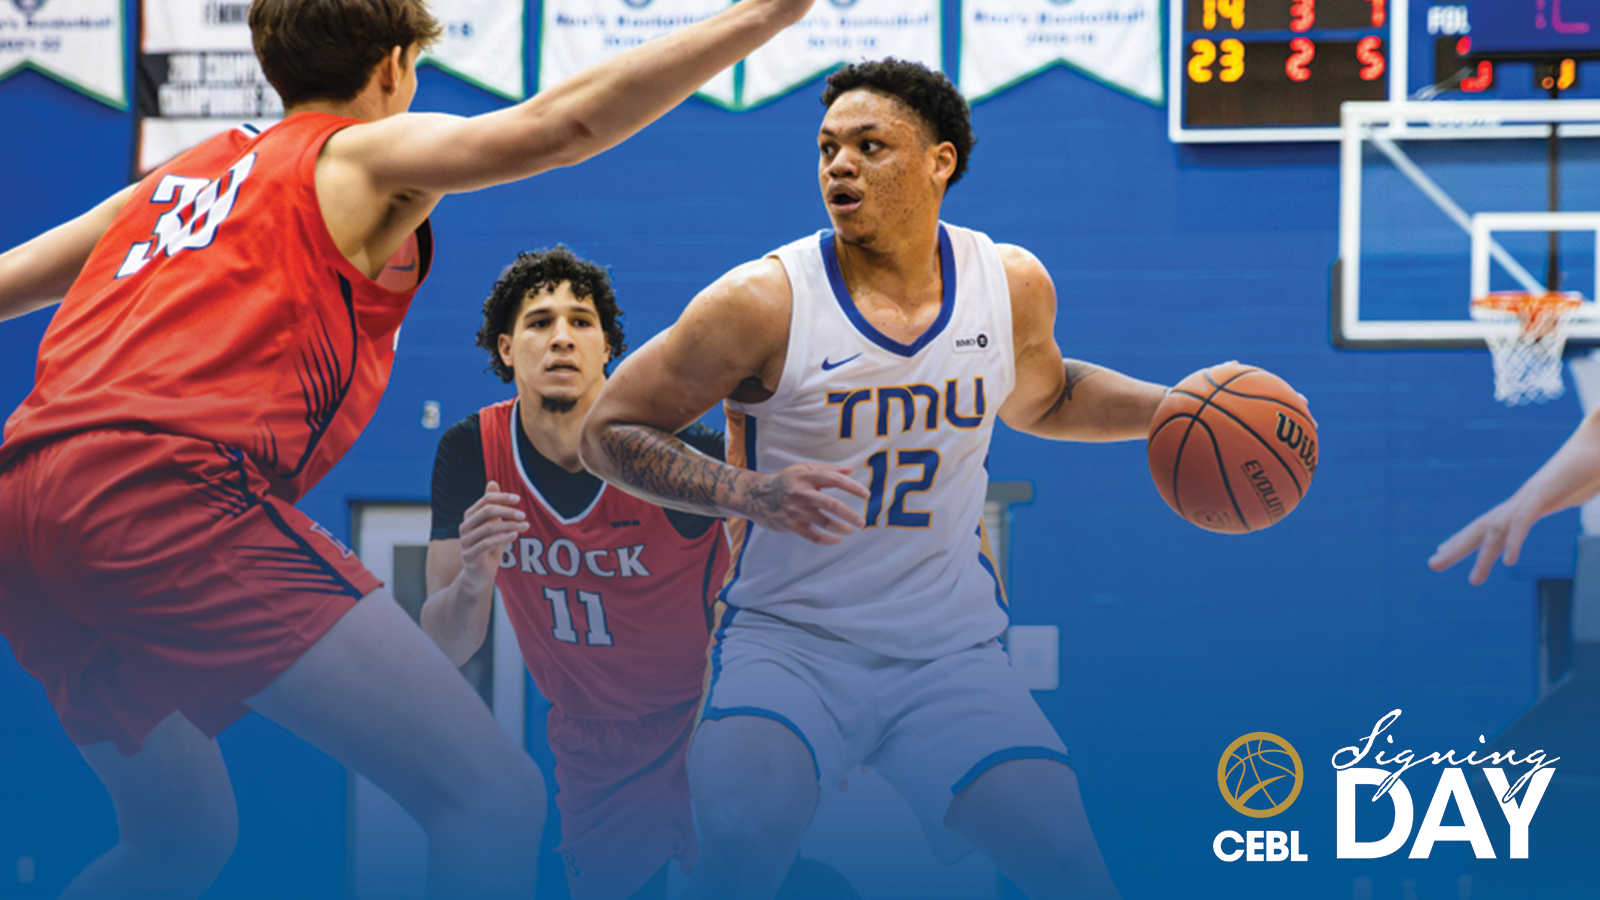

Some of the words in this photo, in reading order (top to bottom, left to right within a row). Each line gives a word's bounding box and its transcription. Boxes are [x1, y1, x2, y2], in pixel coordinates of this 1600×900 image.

[1202, 0, 1246, 30] 14
[1290, 0, 1316, 33] 3
[1187, 38, 1246, 83] 23
[1285, 37, 1316, 82] 2
[1356, 36, 1387, 81] 5
[114, 152, 258, 280] 30
[825, 376, 987, 440] TMU
[862, 448, 943, 530] 12
[498, 536, 652, 578] BROCK
[541, 585, 615, 647] 11
